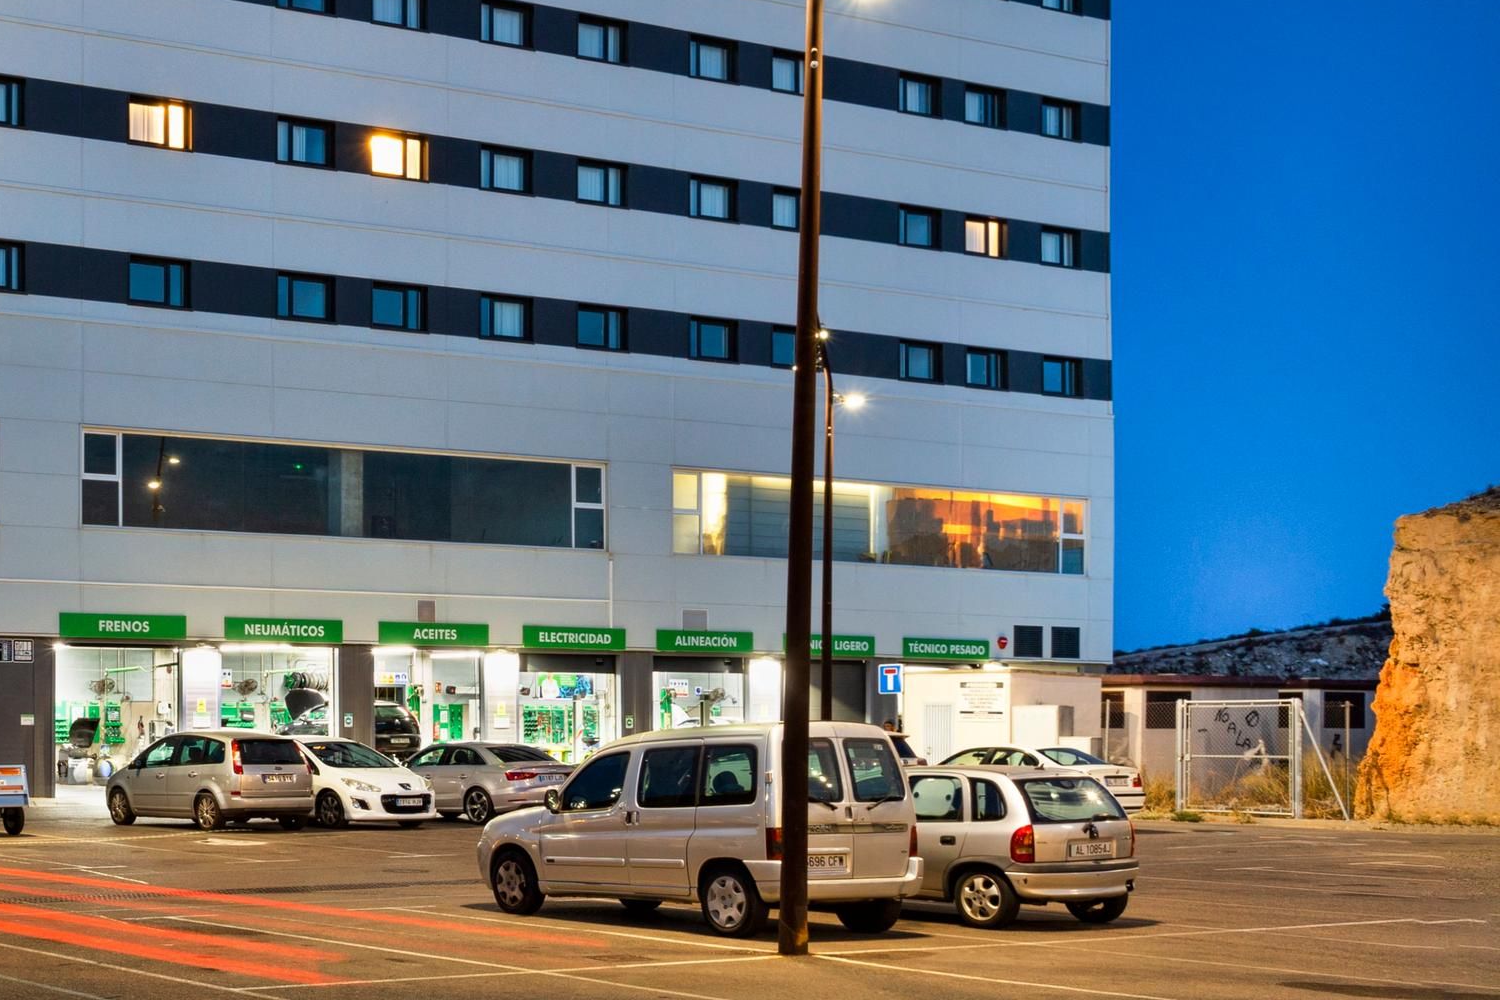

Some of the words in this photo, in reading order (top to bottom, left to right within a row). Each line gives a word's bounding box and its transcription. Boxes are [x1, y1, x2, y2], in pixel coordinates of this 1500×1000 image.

[98, 619, 150, 633] FRENOS
[244, 621, 325, 638] NEUMÁTICOS
[413, 628, 457, 641] ACEITES
[538, 630, 612, 645] ELECTRICIDAD
[674, 633, 738, 648] ALINEACIÓN
[834, 640, 869, 652] LIGERO
[908, 639, 948, 655] TÉCNICO
[949, 643, 986, 656] PESADO
[807, 856, 825, 867] 696
